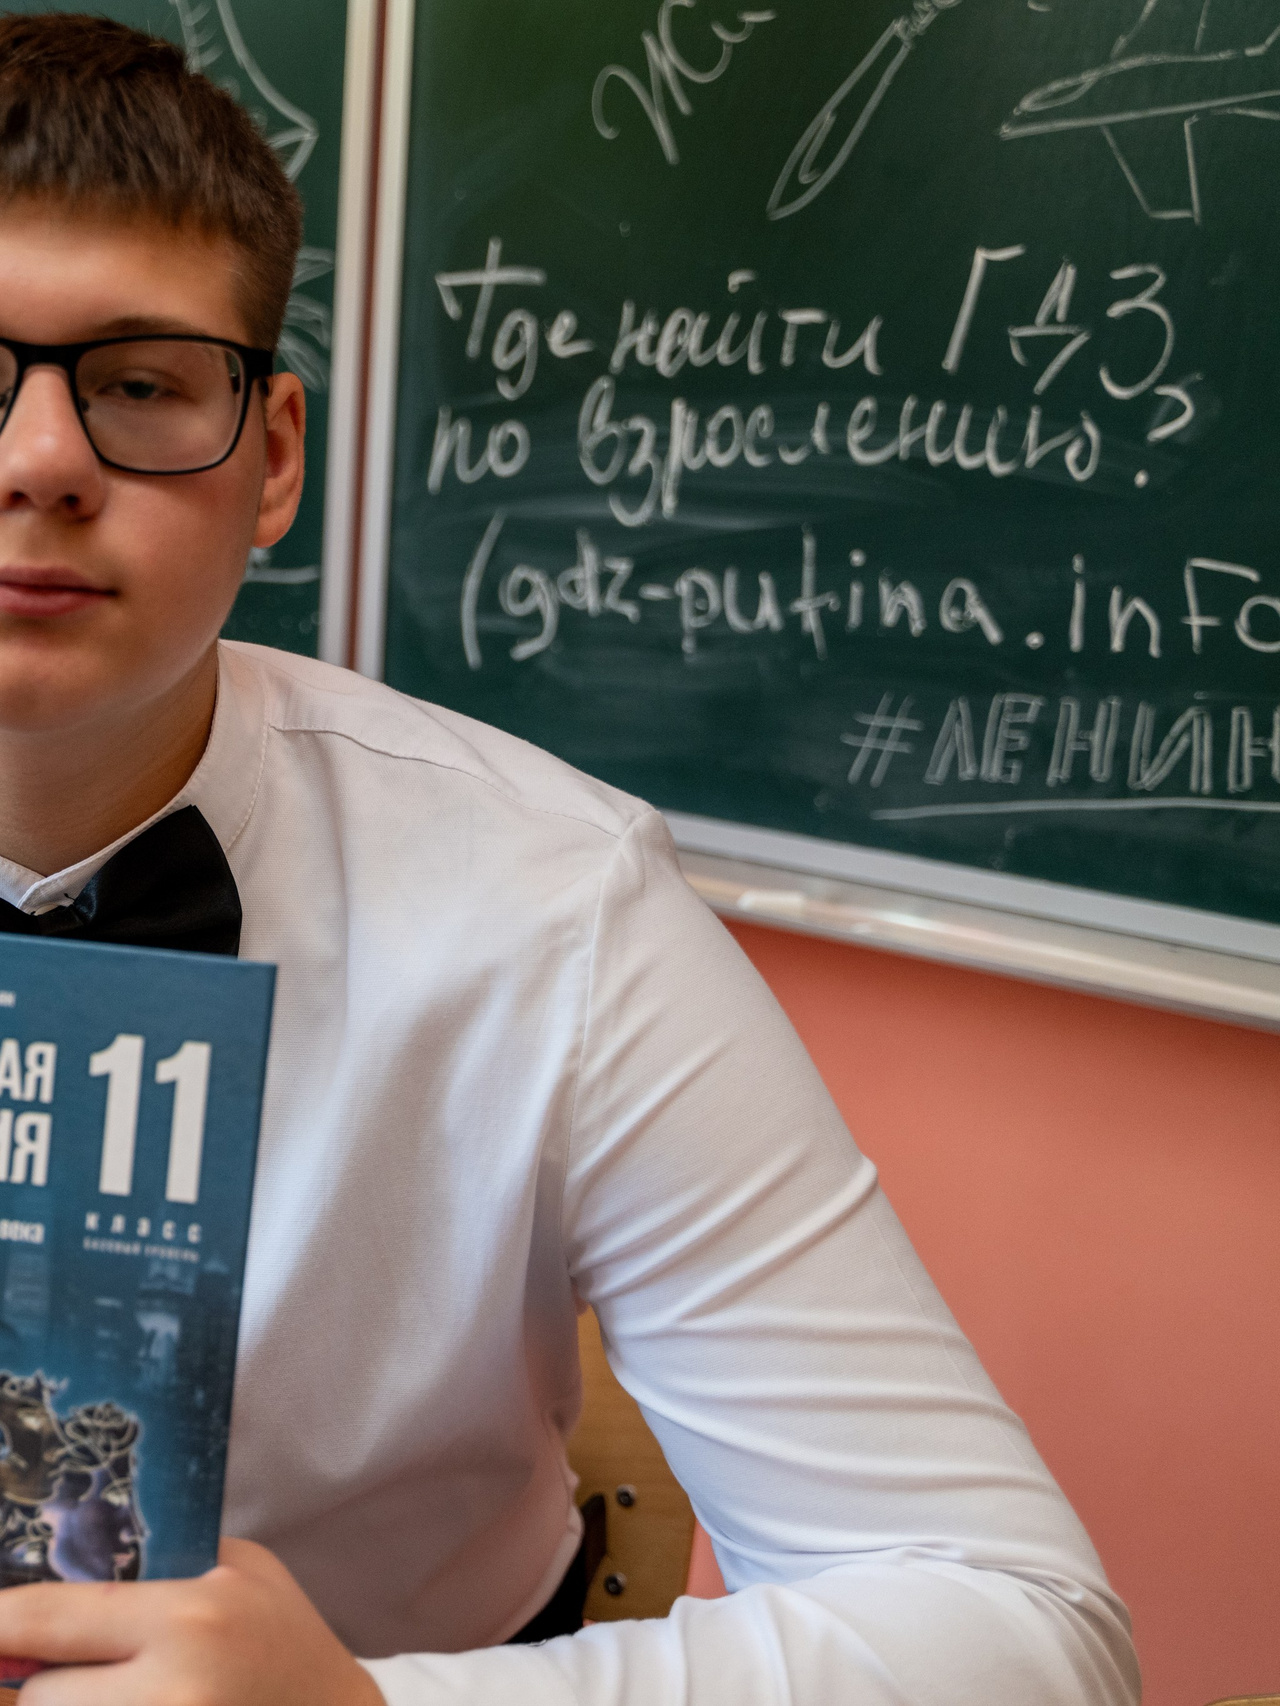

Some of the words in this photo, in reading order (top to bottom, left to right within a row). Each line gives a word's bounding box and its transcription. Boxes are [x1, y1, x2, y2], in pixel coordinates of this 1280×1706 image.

[609, 269, 885, 376] найти
[944, 244, 1176, 401] ГДЗ
[428, 405, 531, 494] по
[89, 1033, 212, 1204] 11
